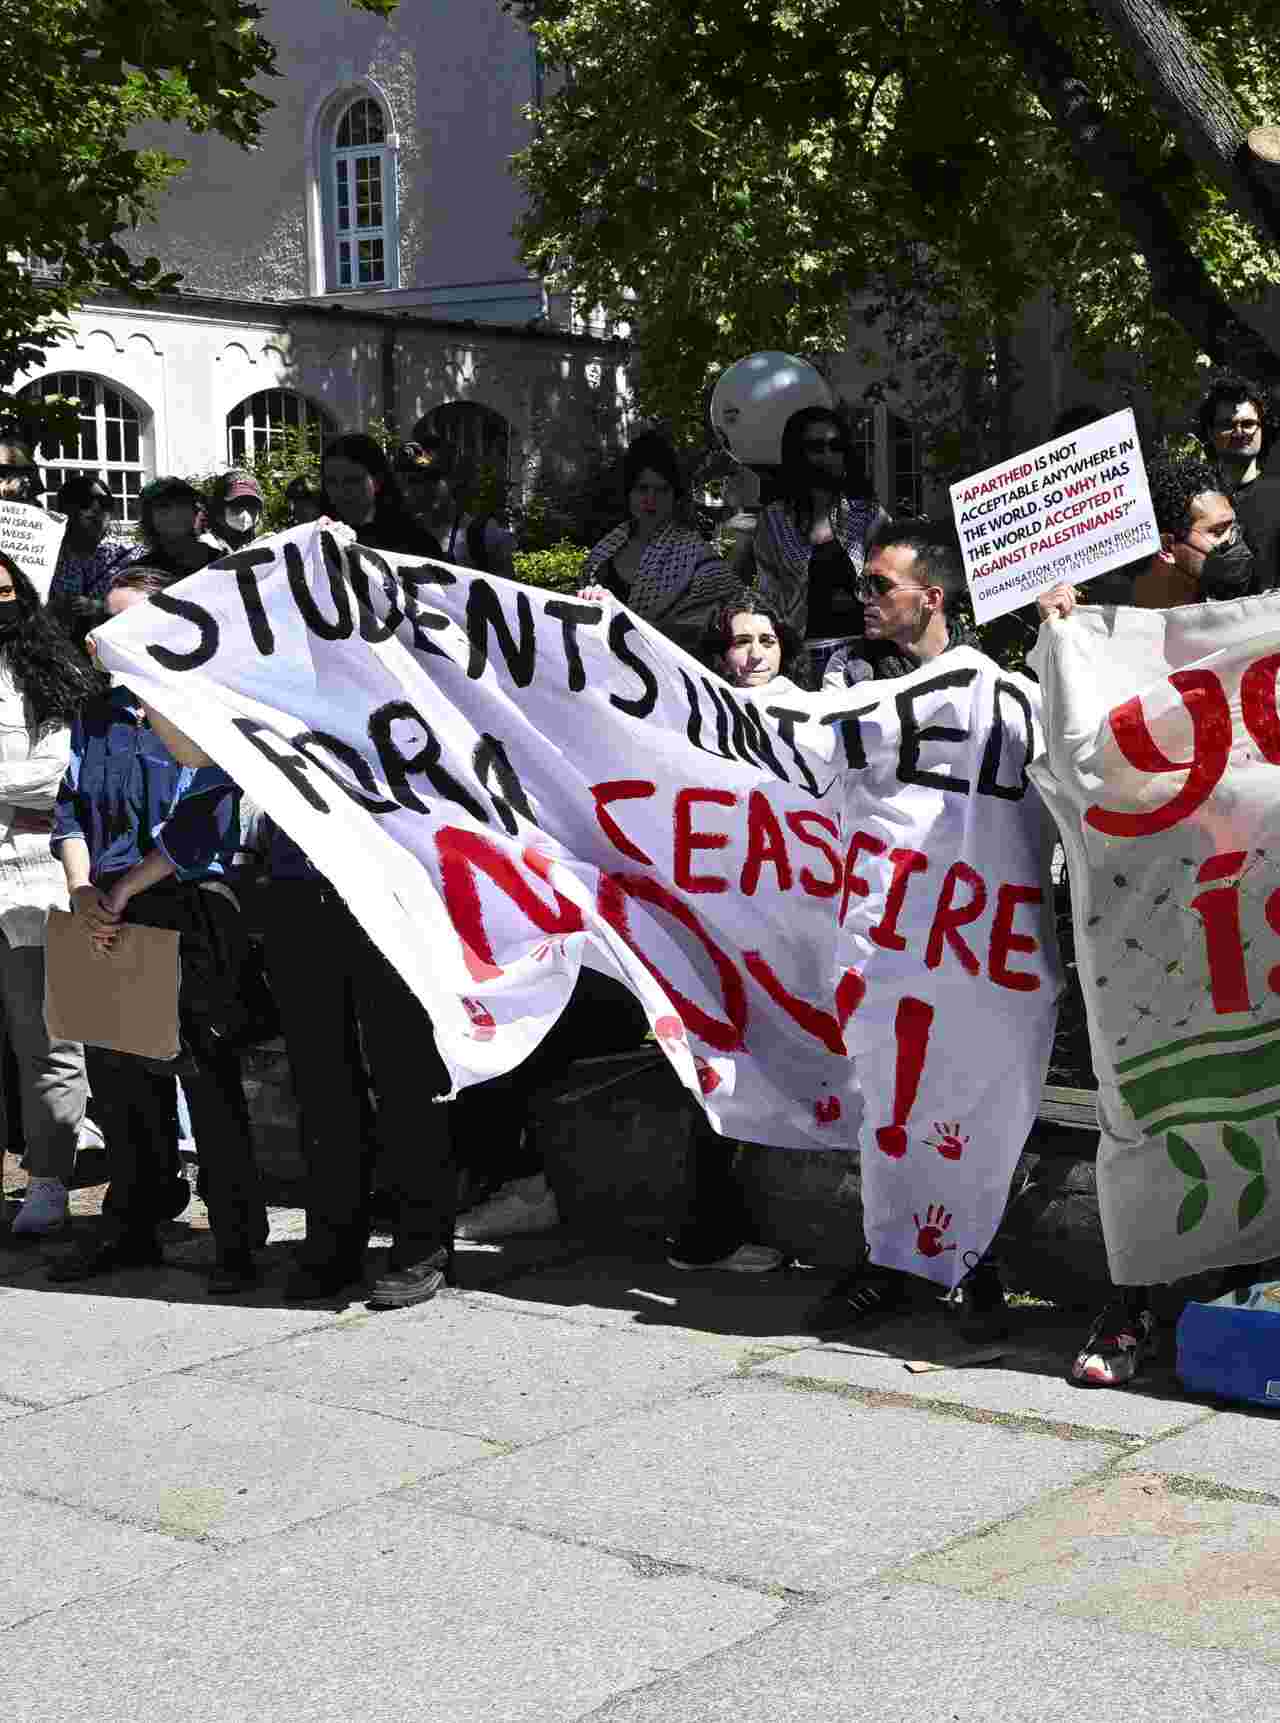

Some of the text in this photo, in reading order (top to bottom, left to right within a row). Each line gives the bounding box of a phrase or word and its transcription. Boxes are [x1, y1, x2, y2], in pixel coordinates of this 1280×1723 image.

[960, 438, 1136, 525] ACCEPTABLE ANYWHERE IN
[1033, 455, 1047, 473] IS
[1049, 441, 1078, 466] NOT
[963, 522, 987, 543] THE
[1043, 491, 1063, 509] SO
[1063, 477, 1097, 499] WHY
[1099, 461, 1131, 483] HAS
[967, 483, 1126, 563] THE WORLD ACCEPTED IT
[971, 546, 1029, 581] AGAINST
[978, 563, 1050, 600] ORGANISATION
[1052, 555, 1072, 568] FOR
[146, 531, 1035, 801] STUDENTS UNITED
[231, 700, 490, 824] FOR
